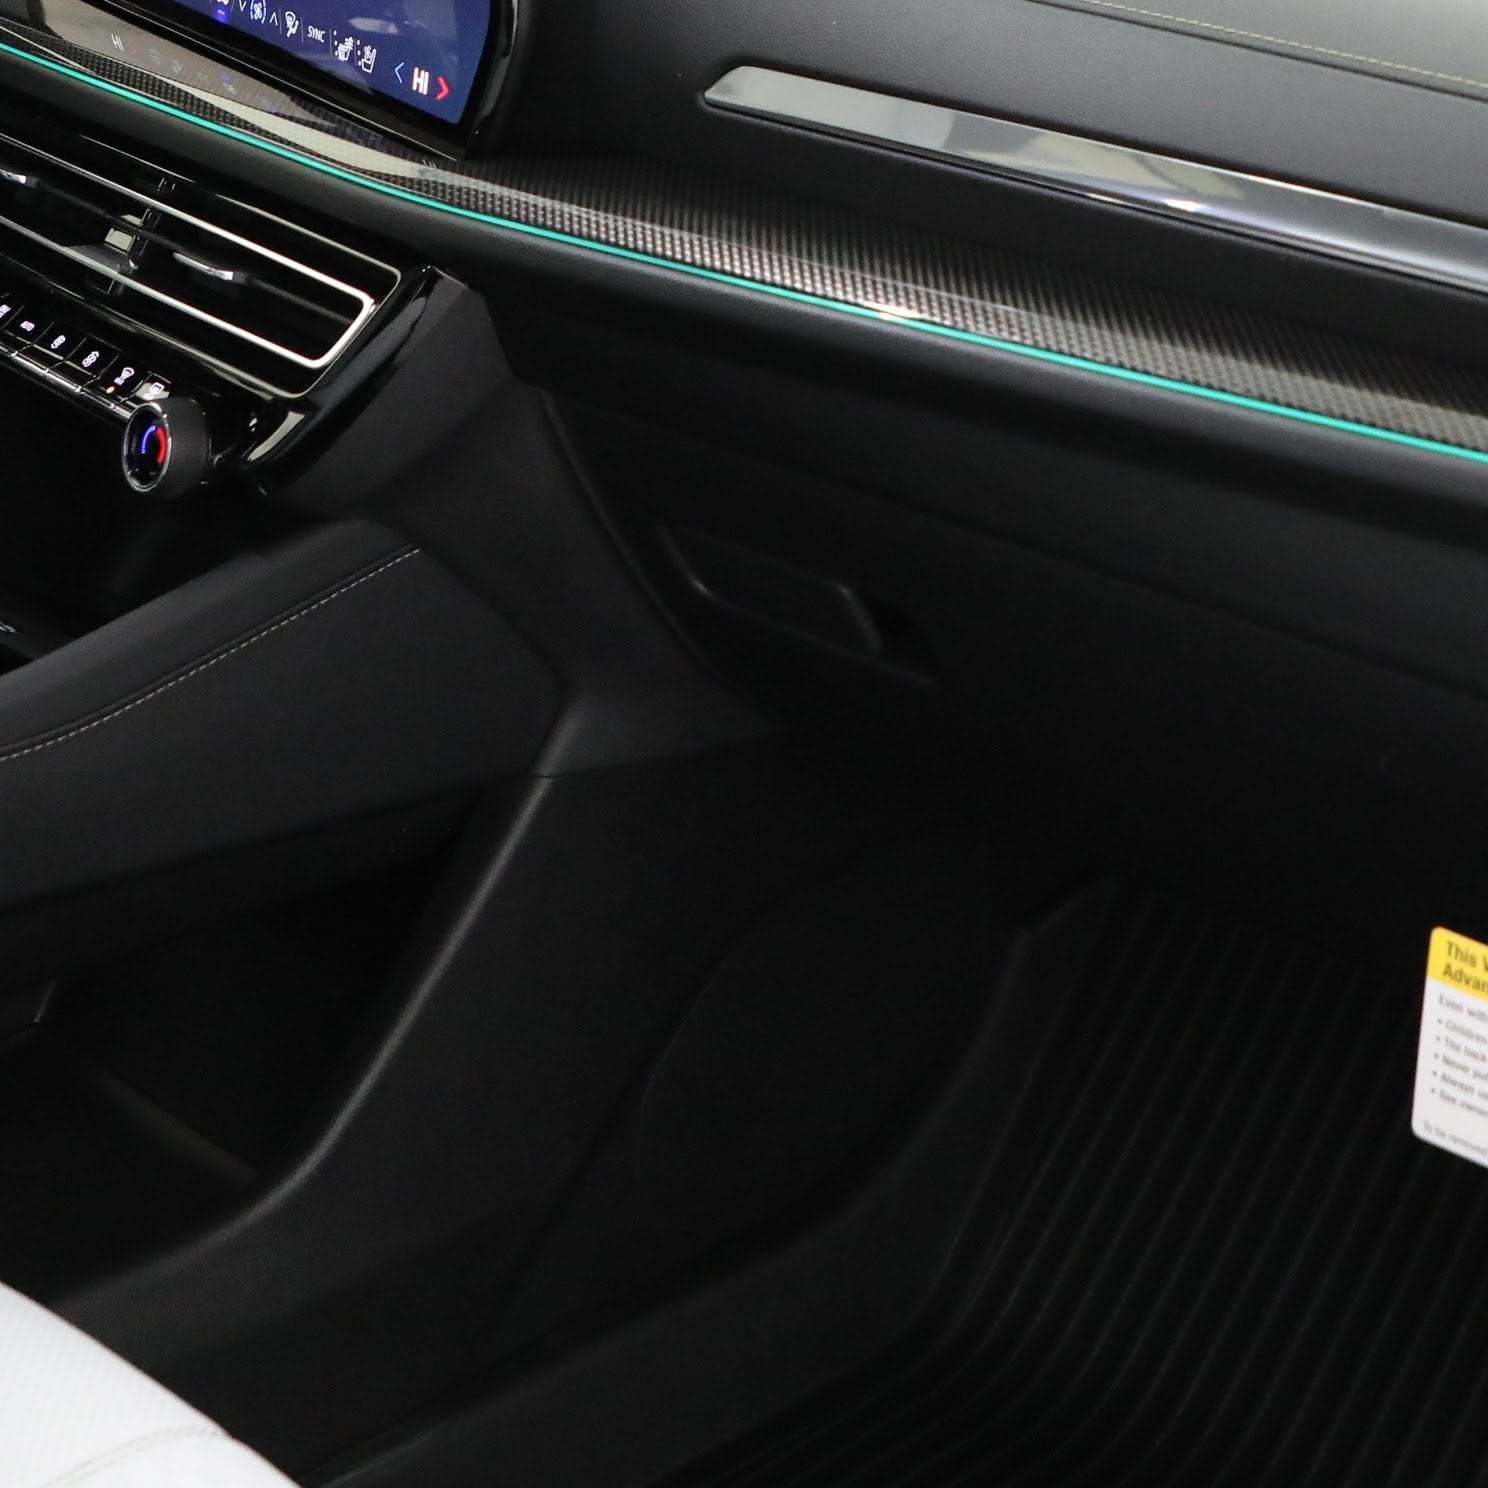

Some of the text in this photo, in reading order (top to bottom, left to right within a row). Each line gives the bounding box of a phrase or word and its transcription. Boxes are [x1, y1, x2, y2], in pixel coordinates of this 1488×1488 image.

[308, 26, 326, 43] SYNC
[412, 67, 430, 96] HI
[1446, 941, 1477, 968] This
[1439, 994, 1463, 1012] Even
